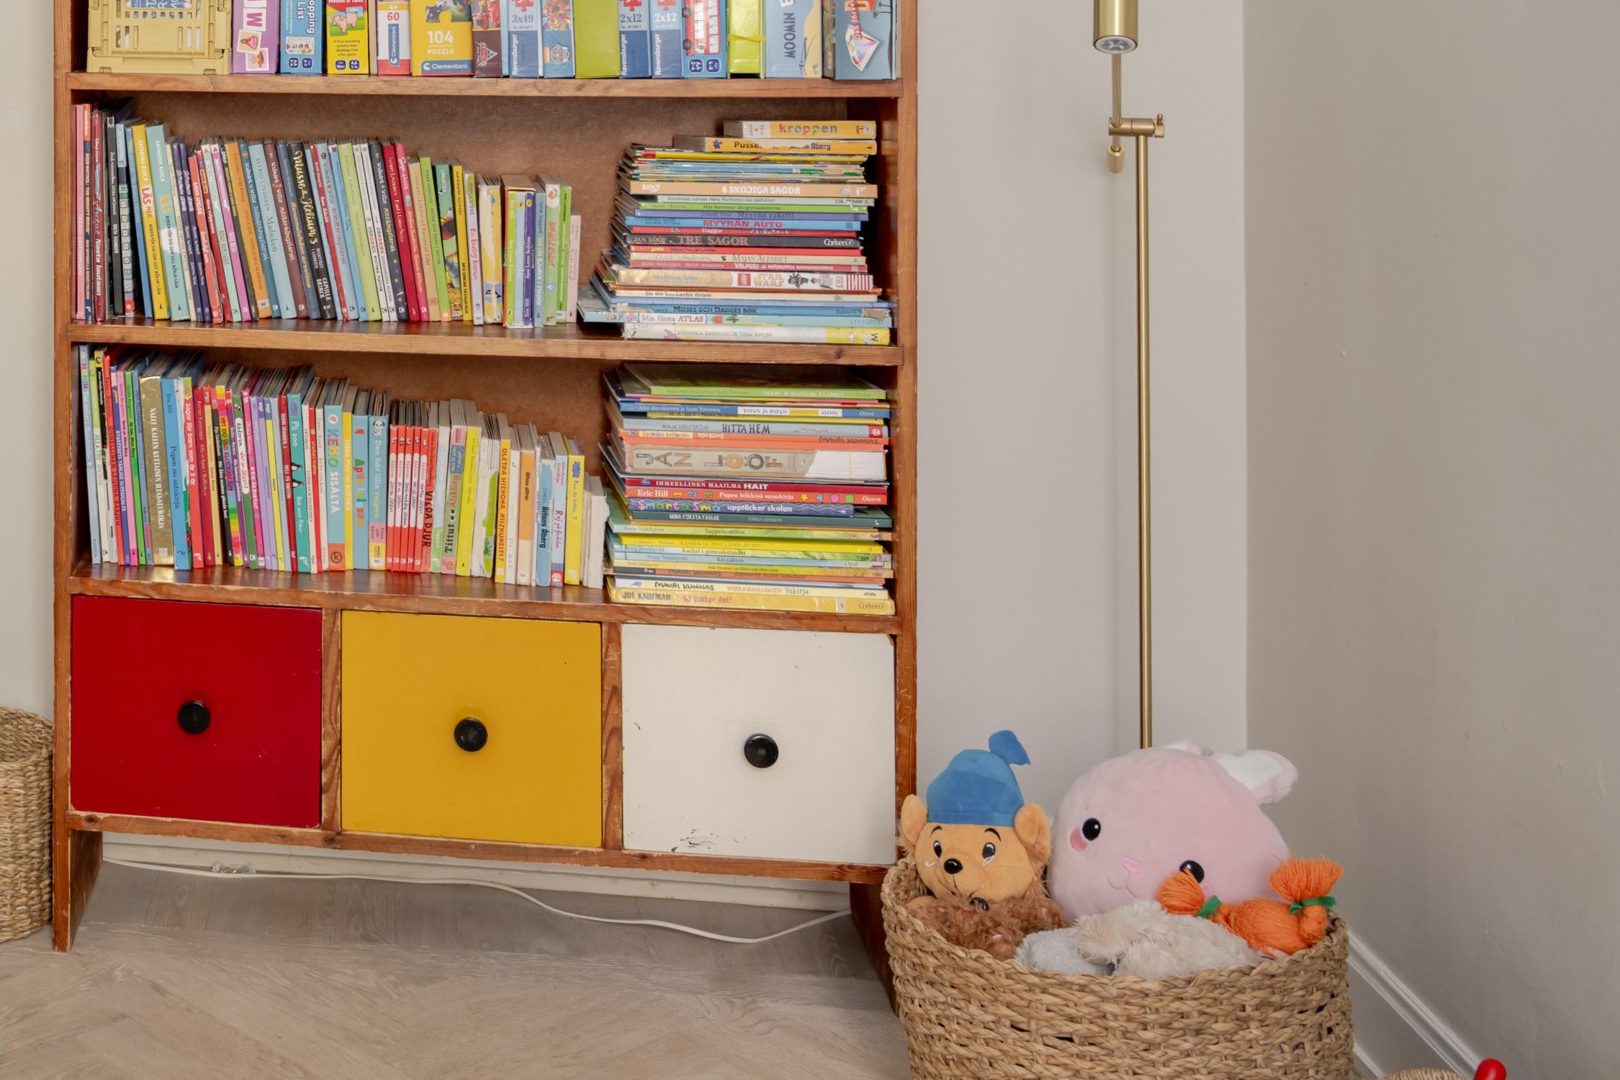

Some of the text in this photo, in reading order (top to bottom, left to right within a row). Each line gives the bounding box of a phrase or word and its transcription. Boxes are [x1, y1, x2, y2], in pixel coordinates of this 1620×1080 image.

[297, 1, 305, 20] List
[387, 12, 399, 21] 60
[512, 14, 533, 23] 3x49
[620, 14, 642, 23] 2x12
[654, 12, 677, 22] 2x12
[428, 30, 454, 44] 104
[784, 12, 796, 59] MOOMIN
[854, 24, 862, 40] Den
[779, 123, 837, 135] kroppen
[137, 140, 153, 205] KATARINA KUICK LÄS
[156, 140, 175, 213] KATARINA KUICK LÄS
[293, 151, 305, 189] Musse
[300, 196, 314, 236] Helium
[703, 219, 750, 227] MYYRÄN
[266, 216, 278, 252] Madicken
[470, 228, 476, 238] En
[677, 235, 702, 244] TRE
[707, 236, 748, 246] SAGOR
[291, 201, 311, 288] Sanomalehden arvoitus
[468, 239, 478, 257] busig
[95, 238, 103, 296] Nasta lautaan
[316, 279, 325, 299] BRINCK
[322, 277, 330, 301] CAMILLA
[184, 403, 192, 421] sagor
[292, 421, 300, 431] På
[722, 424, 770, 433] HITTA HEM
[169, 446, 178, 465] Pupen
[374, 457, 382, 471] här
[636, 452, 783, 470] JAN LÖÖF
[149, 407, 165, 529] NALLE KALLEN KULTAINEN ILTASATUKIRJA
[327, 428, 341, 513] KEHO SISÄLTÄ
[374, 473, 382, 490] lilla
[173, 479, 181, 509] satukirja
[637, 489, 653, 497] Eric
[373, 491, 381, 519] valpen
[424, 490, 433, 519] VILDA
[638, 501, 690, 511] Smarta
[693, 501, 721, 511] Små
[445, 475, 460, 553] Tittut Älskling
[422, 522, 432, 548] DJUR
[539, 528, 548, 548] Åberg
[638, 593, 671, 601] KAUFMAN
